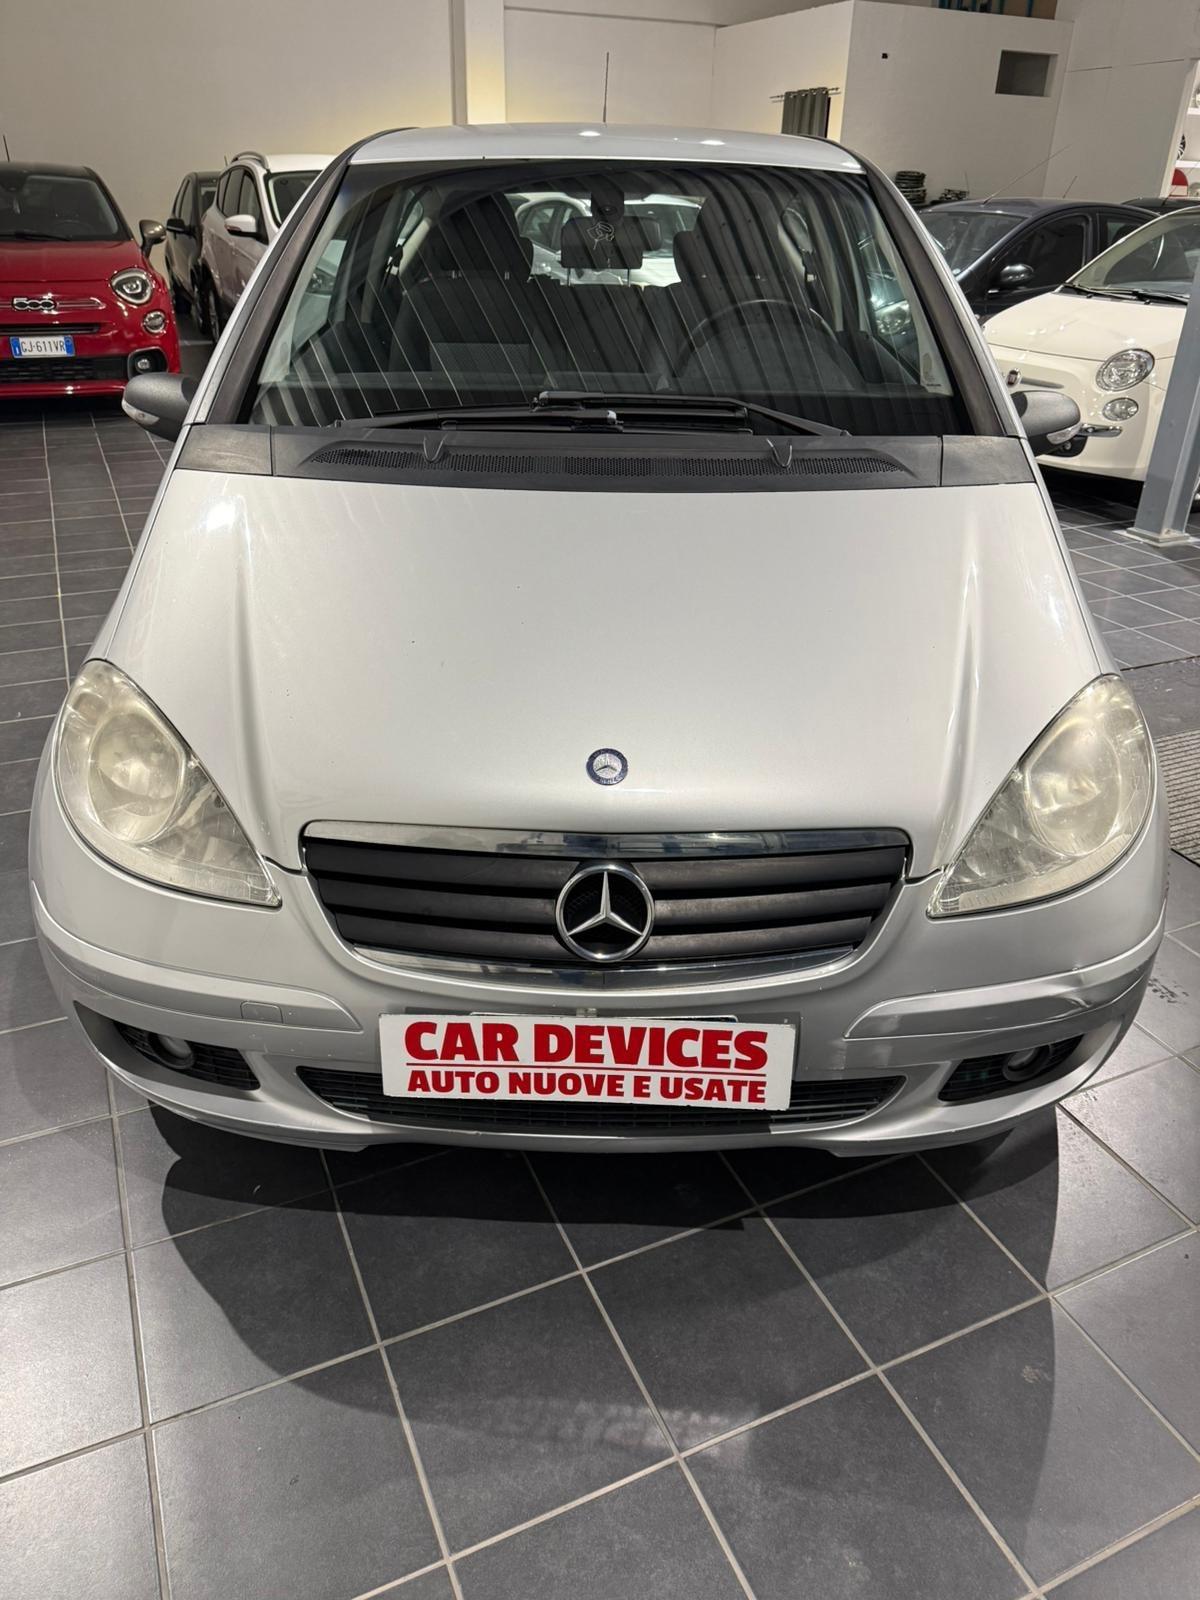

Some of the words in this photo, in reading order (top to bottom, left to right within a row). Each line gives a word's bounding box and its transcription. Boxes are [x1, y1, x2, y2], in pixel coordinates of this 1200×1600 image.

[403, 1021, 519, 1062] CAR
[533, 1023, 768, 1070] DEVICES
[407, 1069, 500, 1094] AUTO
[508, 1072, 625, 1097] NUOVE
[632, 1076, 651, 1098] E
[659, 1076, 767, 1104] USATE
